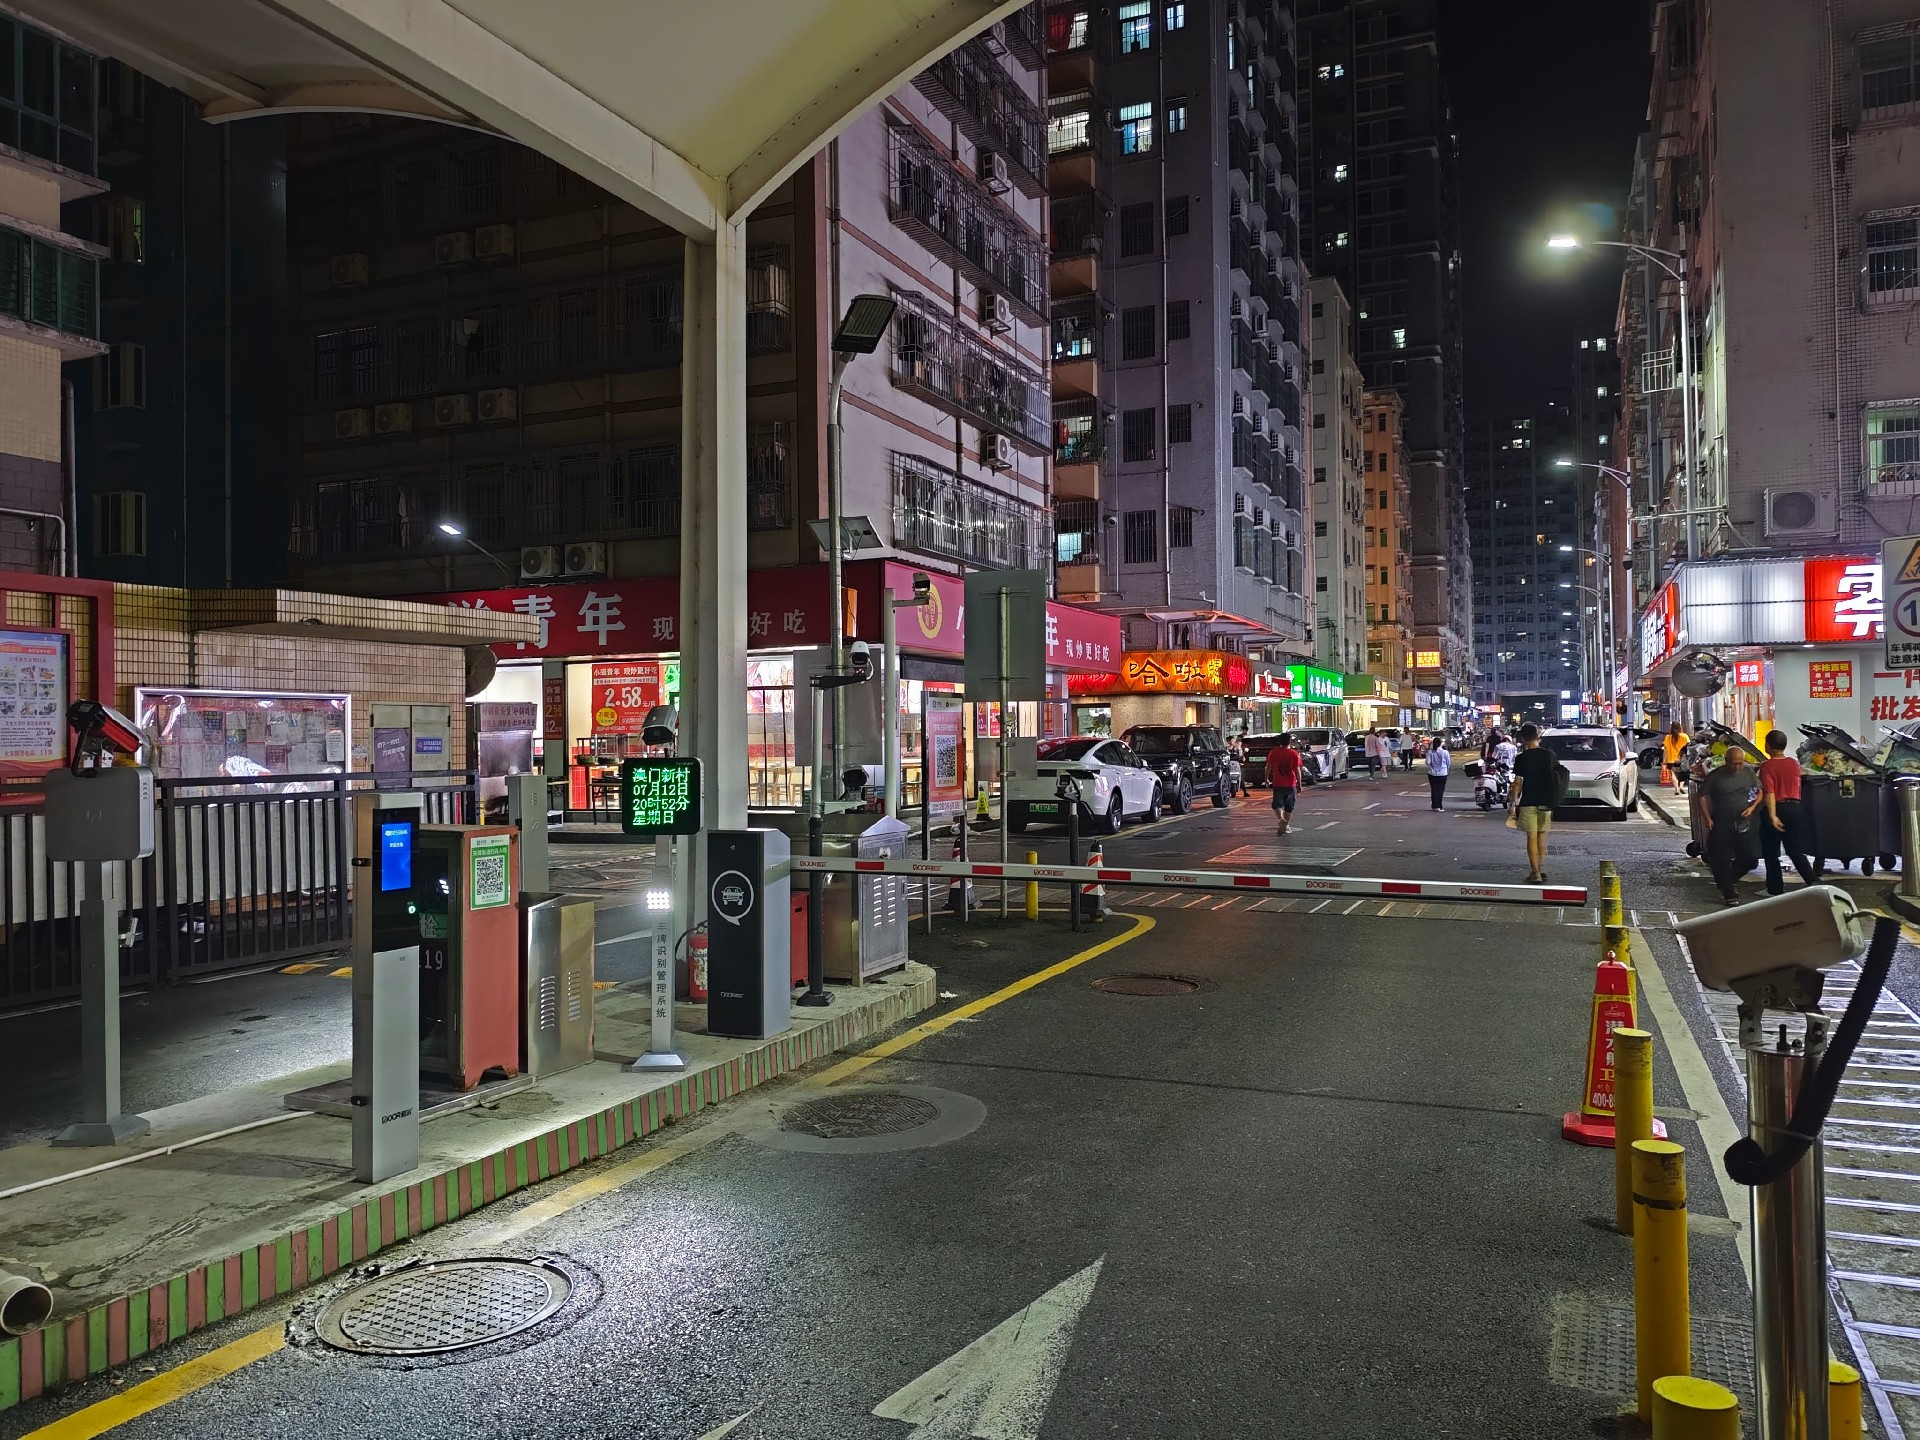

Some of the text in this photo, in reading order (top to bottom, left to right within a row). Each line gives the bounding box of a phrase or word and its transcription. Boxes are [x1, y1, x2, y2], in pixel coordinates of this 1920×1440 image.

[1065, 638, 1110, 663] 现炒更好吃
[1739, 665, 1758, 674] 零食
[604, 686, 642, 708] 2.58
[632, 766, 691, 783] 澳门新村
[632, 781, 688, 796] 07月12日
[632, 796, 691, 811] 20时52分
[632, 810, 674, 826] 星期日
[656, 921, 667, 1018] 车牌识别管理系统
